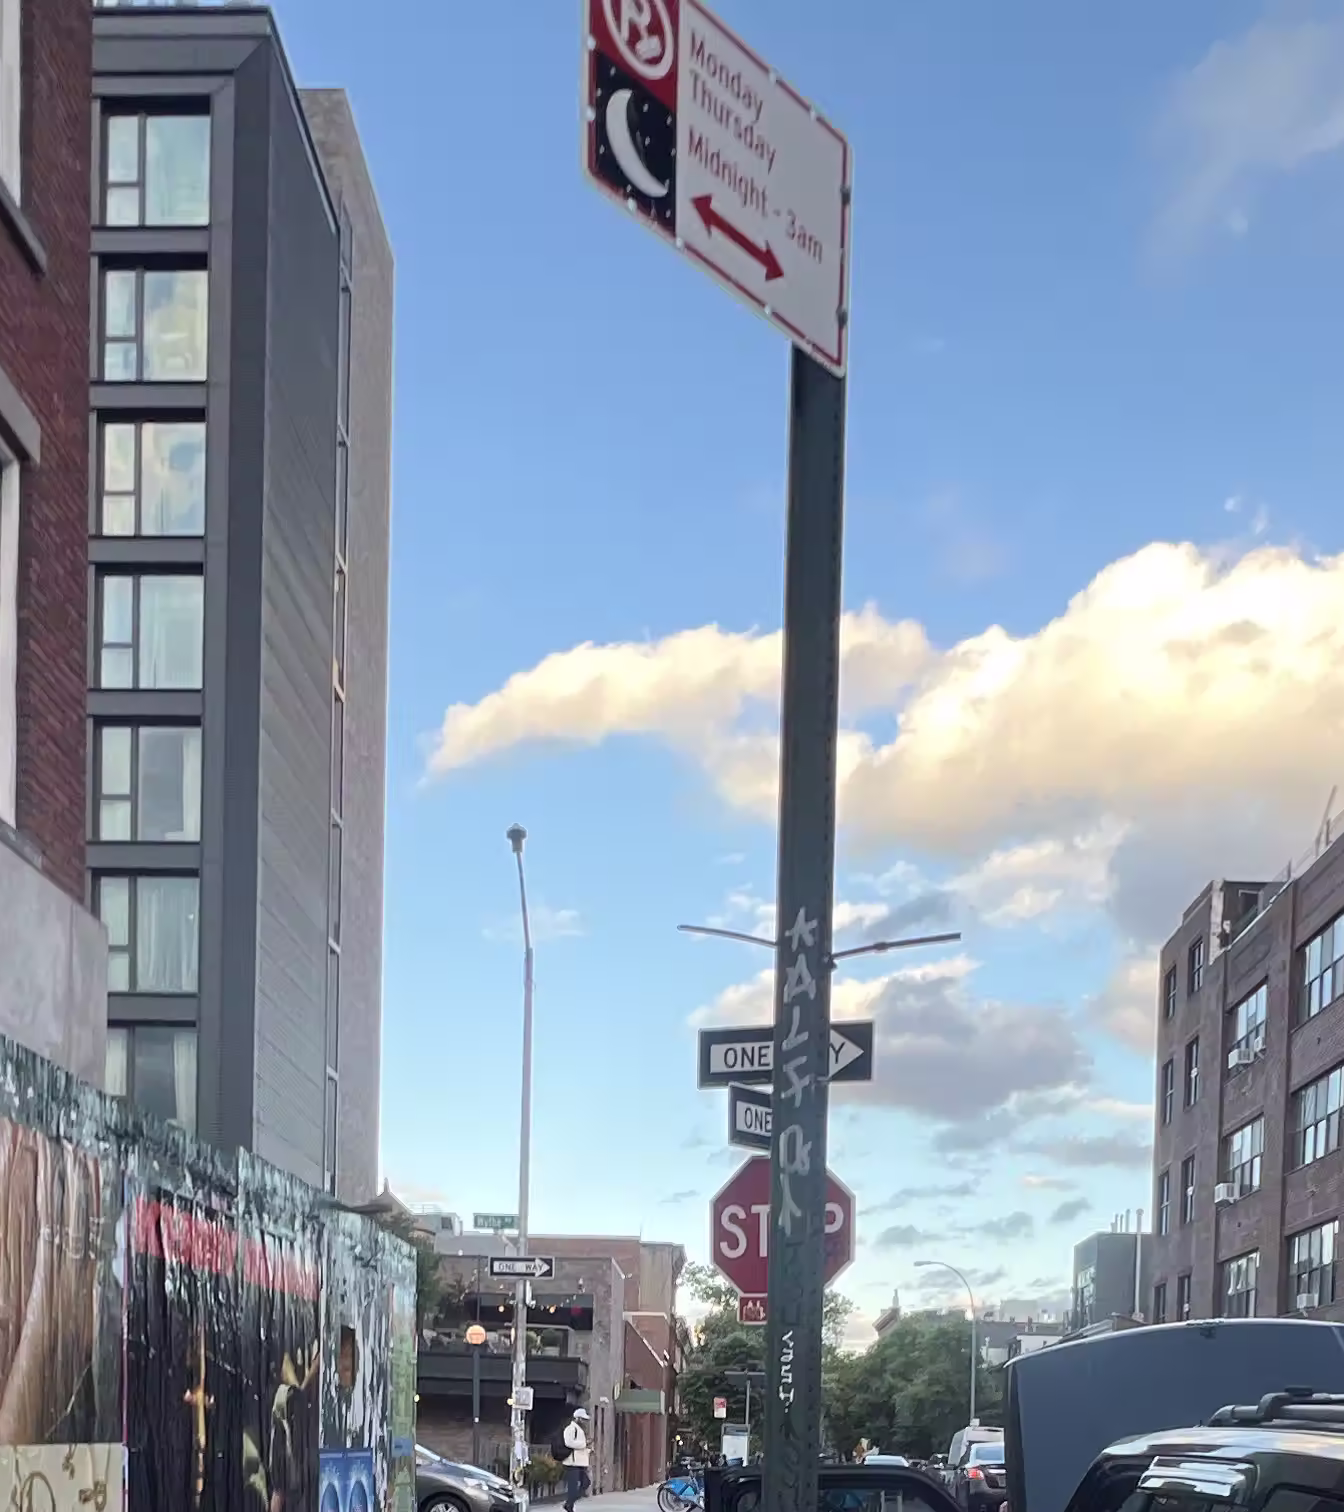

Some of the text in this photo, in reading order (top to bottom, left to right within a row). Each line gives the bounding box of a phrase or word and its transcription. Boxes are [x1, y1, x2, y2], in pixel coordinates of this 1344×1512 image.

[690, 31, 763, 123] Monday
[690, 68, 776, 175] Thursday
[689, 125, 768, 218] Midnight
[786, 208, 823, 264] 3am
[723, 1046, 771, 1069] ONE
[743, 1108, 773, 1134] ONE
[719, 1203, 844, 1259] STP
[525, 1262, 544, 1271] WAY
